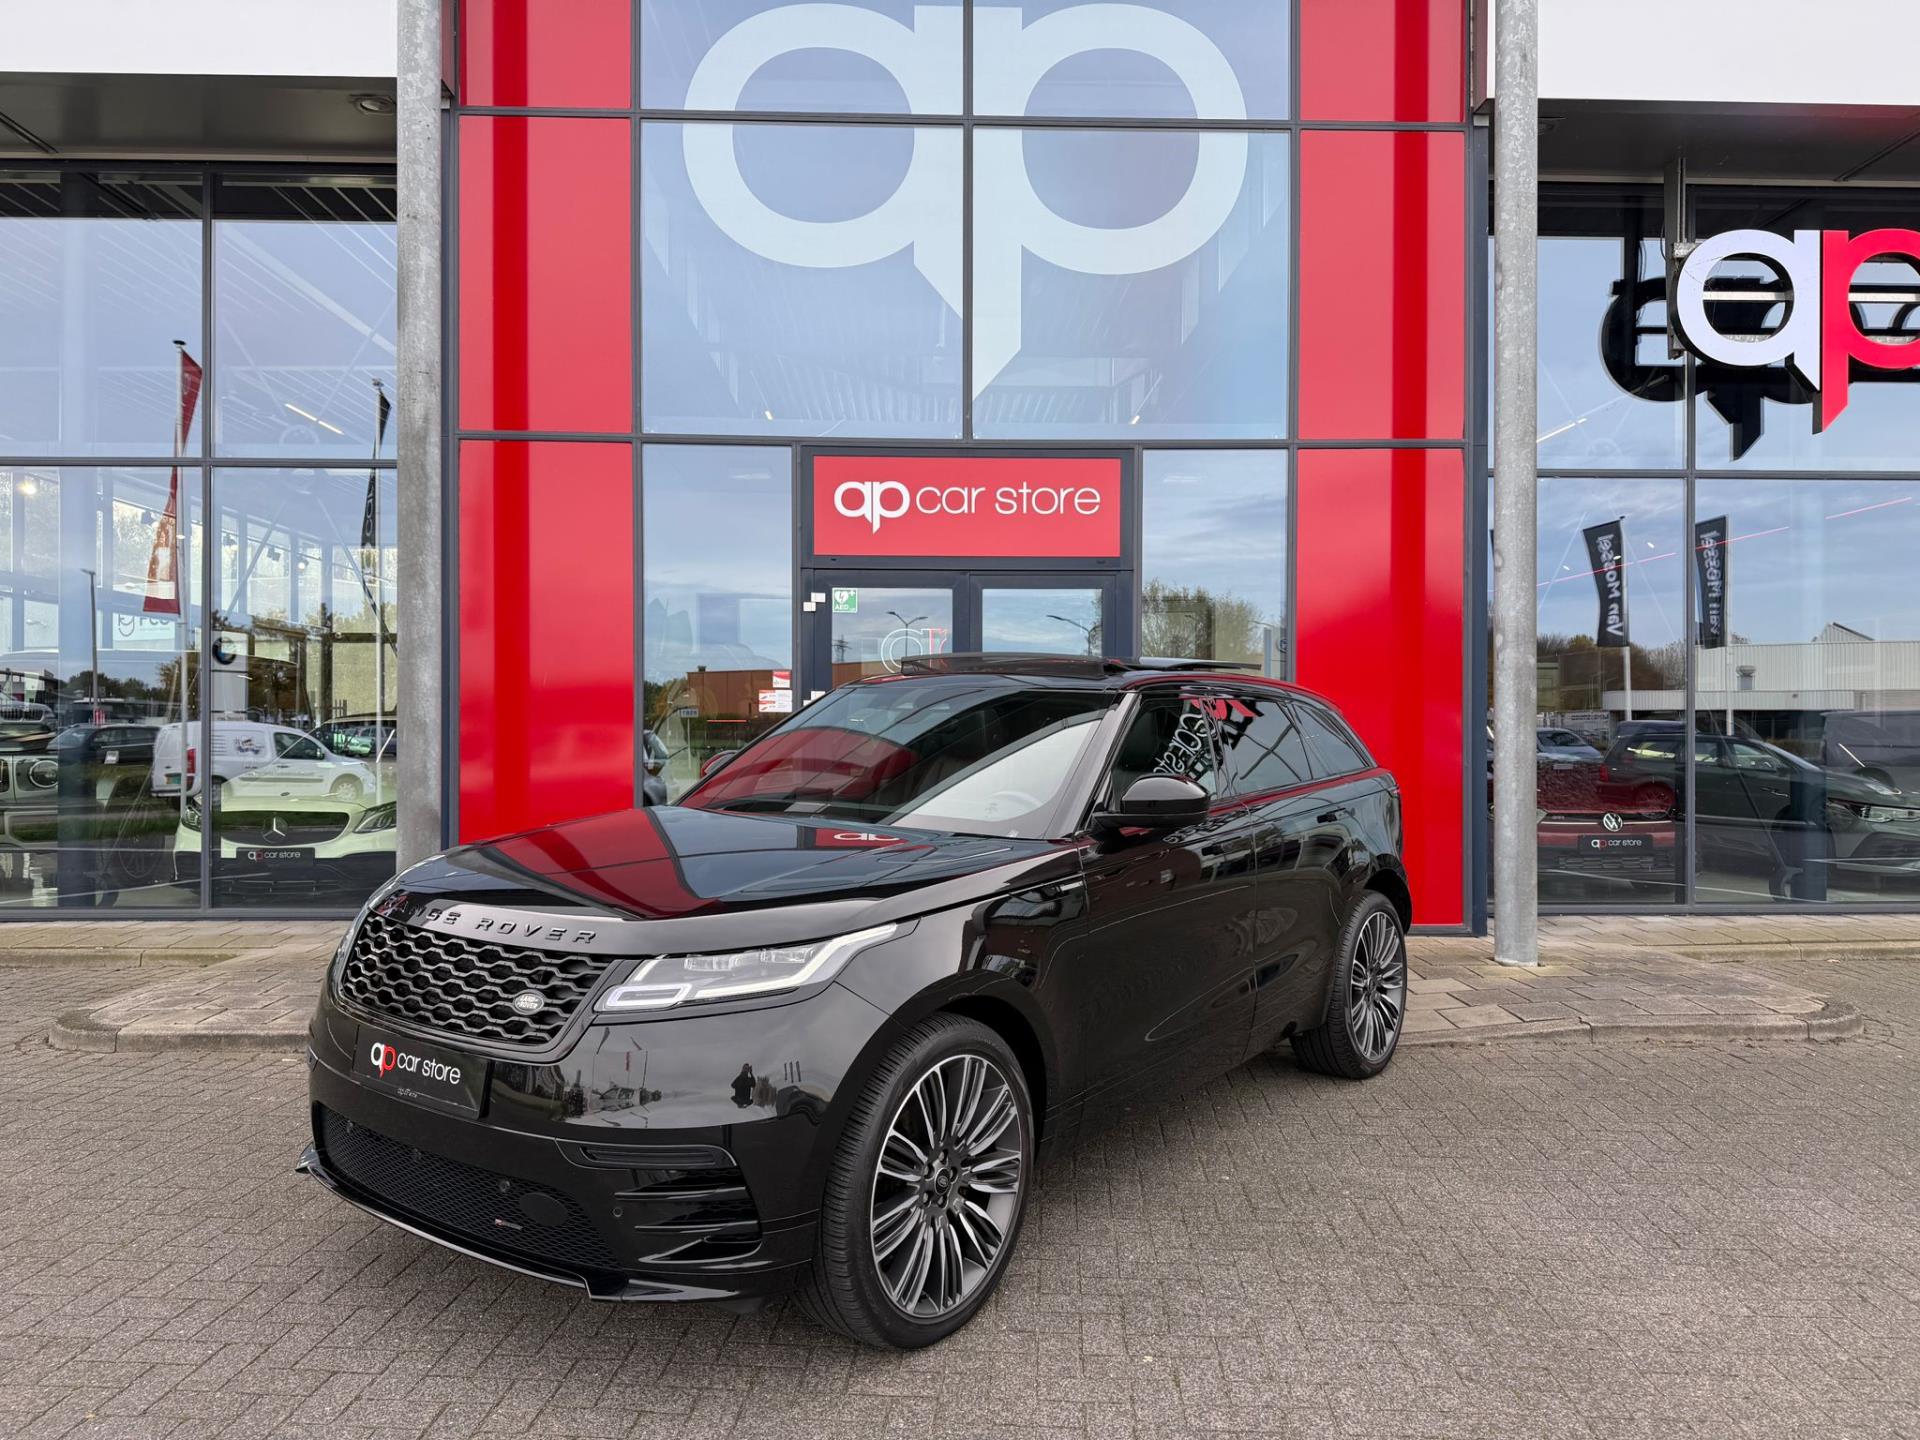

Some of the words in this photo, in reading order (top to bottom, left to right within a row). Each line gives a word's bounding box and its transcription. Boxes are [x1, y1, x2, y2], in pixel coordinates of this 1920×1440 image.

[833, 480, 911, 534] ap
[915, 486, 986, 514] car
[995, 481, 1101, 515] store
[475, 917, 596, 944] ROVER
[370, 1042, 397, 1077] ap
[397, 1052, 421, 1073] car
[422, 1058, 461, 1085] store
